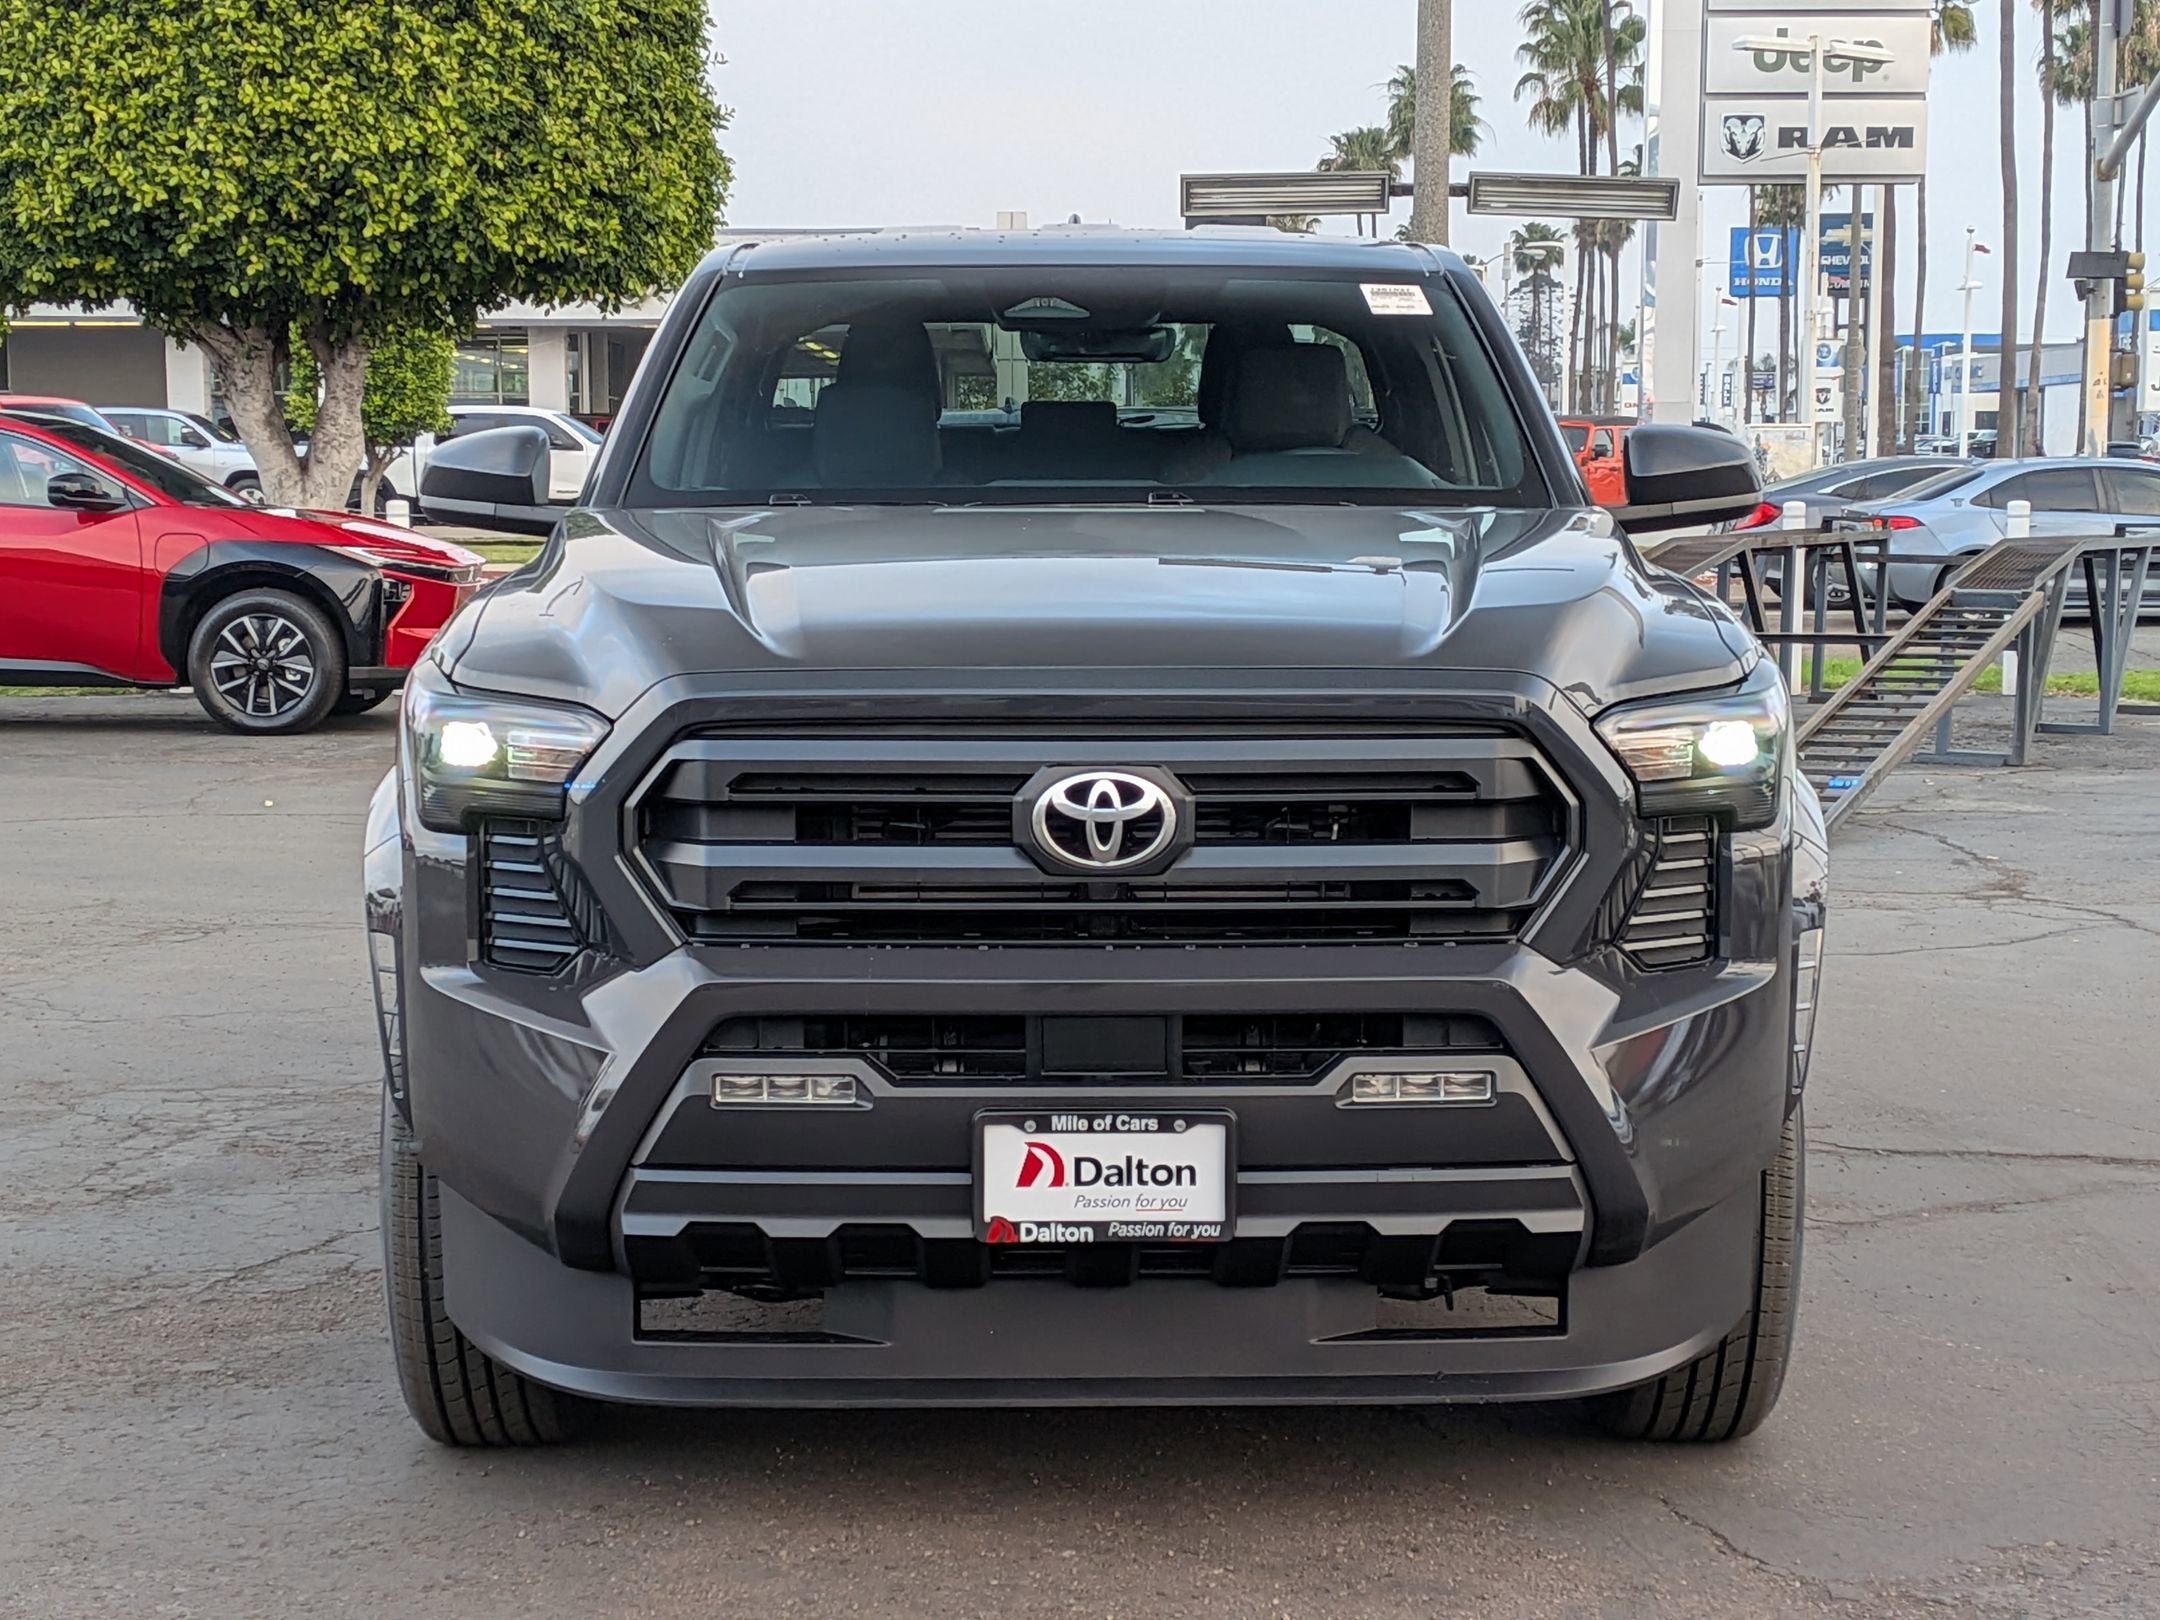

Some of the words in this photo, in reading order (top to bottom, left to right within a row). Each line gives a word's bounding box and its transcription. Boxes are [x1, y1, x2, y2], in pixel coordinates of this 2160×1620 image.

[1778, 126, 1914, 149] RAM
[1051, 1115, 1088, 1131] Mile
[1093, 1115, 1113, 1131] of
[1116, 1115, 1158, 1131] Cars
[1073, 1155, 1197, 1187] Dalton
[1073, 1194, 1131, 1209] Passion
[1135, 1194, 1156, 1209] for
[1159, 1197, 1188, 1211] you
[1020, 1222, 1094, 1243] Dalton
[1107, 1221, 1165, 1237] Passion
[1167, 1221, 1191, 1237] for
[1191, 1224, 1221, 1239] you
